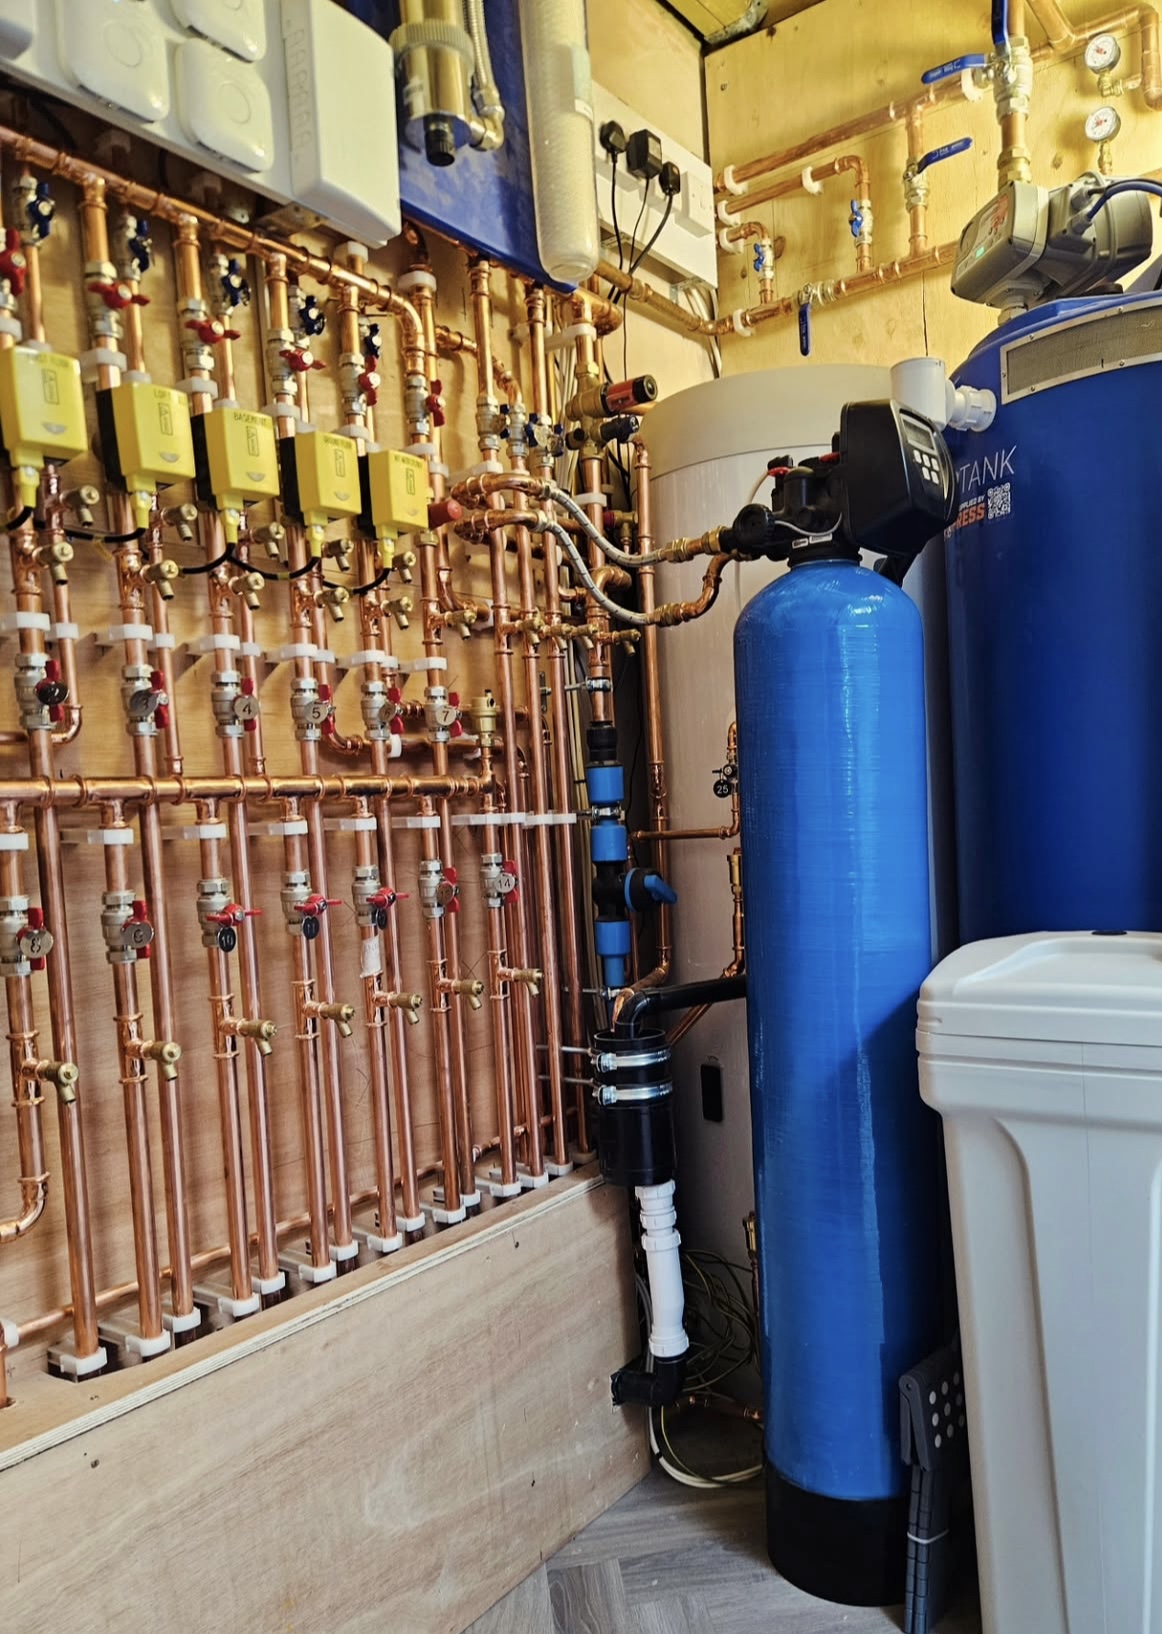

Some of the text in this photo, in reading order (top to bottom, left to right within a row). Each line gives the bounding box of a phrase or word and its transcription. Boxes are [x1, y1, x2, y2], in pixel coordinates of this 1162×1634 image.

[233, 412, 267, 426] BASEMENT
[141, 697, 149, 709] 3
[242, 701, 252, 715] 4
[312, 706, 321, 720] 5
[442, 710, 449, 722] 7
[716, 784, 729, 794] 25
[498, 878, 511, 889] 14
[31, 936, 41, 953] 8
[221, 935, 234, 947] 10
